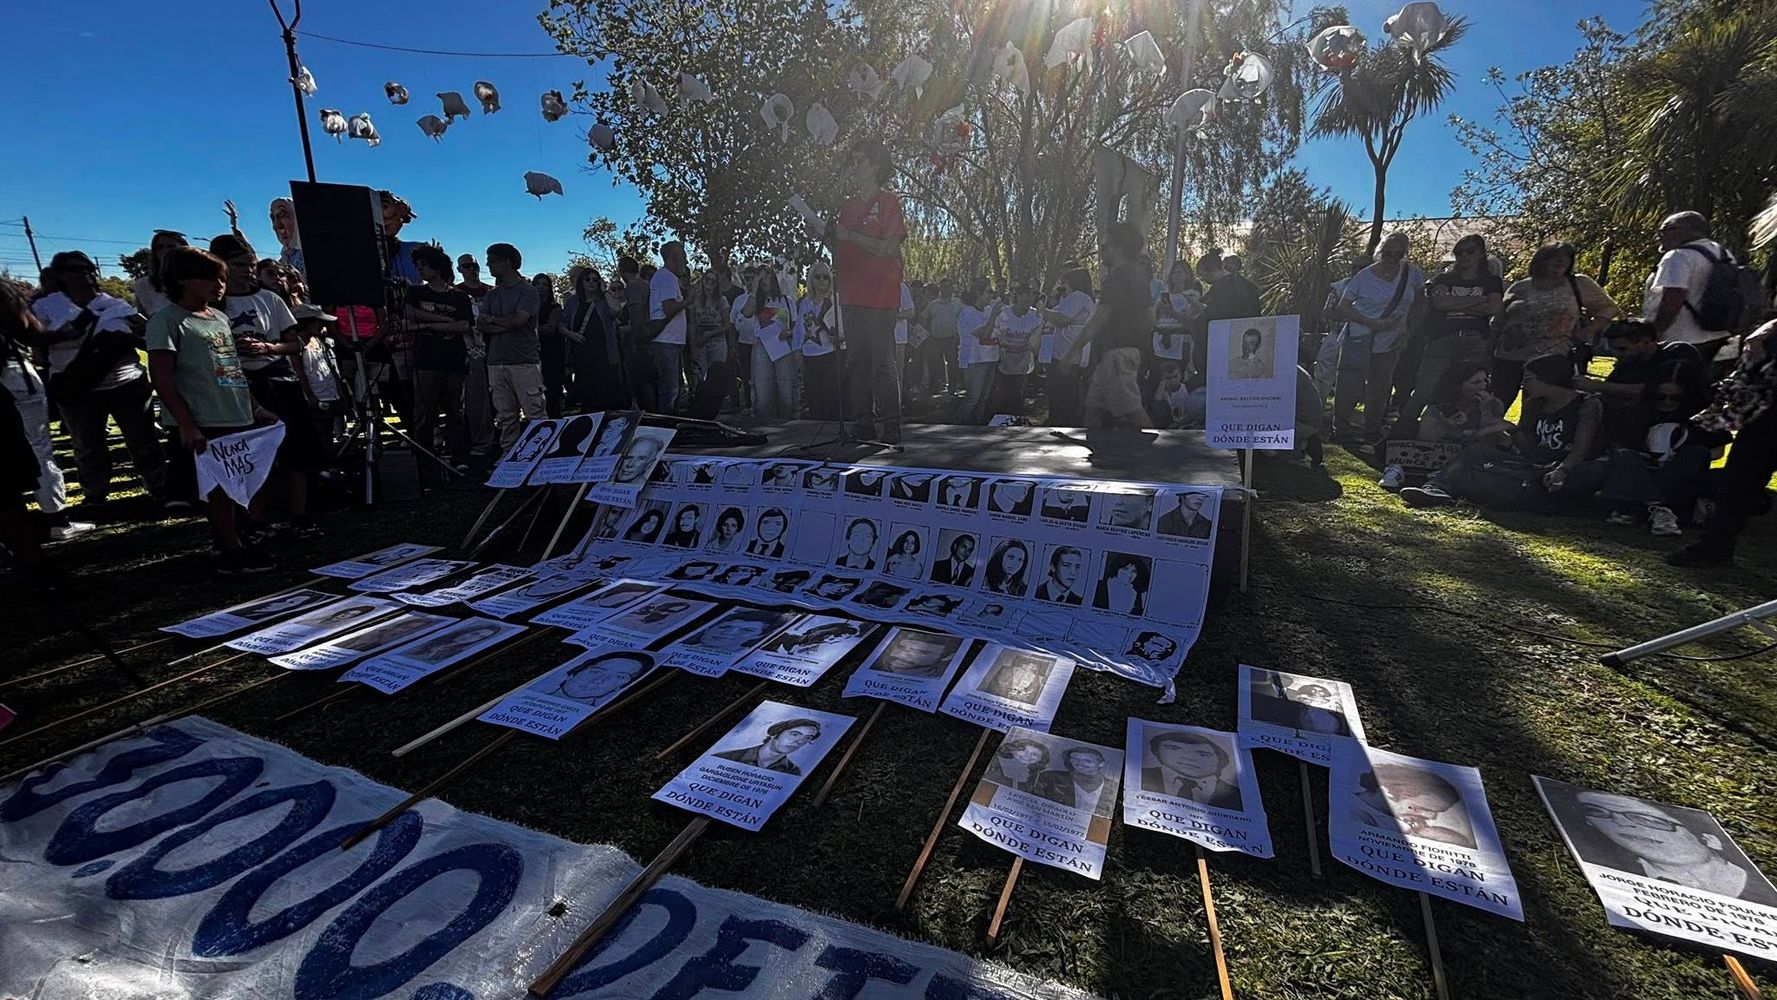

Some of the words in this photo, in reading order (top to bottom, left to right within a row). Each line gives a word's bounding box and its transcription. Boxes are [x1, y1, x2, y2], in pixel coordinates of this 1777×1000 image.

[1213, 434, 1250, 444] DÓNDE
[1253, 434, 1288, 444] ESTÁN
[1221, 424, 1244, 432] QUE
[1246, 424, 1281, 432] DIGAN
[210, 438, 250, 462] NUNCA
[590, 633, 608, 641] QUE
[608, 639, 637, 648] DIGAN
[692, 654, 722, 666] DIGAN
[755, 660, 775, 670] QUE
[778, 665, 812, 676] DIGAN
[864, 680, 888, 690] QUE
[488, 712, 522, 726] DÓNDE
[525, 720, 562, 736] ESTÁN
[509, 704, 531, 714] QUE
[532, 710, 568, 723] DIGAN
[950, 707, 994, 725] DÓNDE
[964, 701, 992, 714] QUE
[993, 709, 1034, 726] DIGAN
[700, 774, 740, 789] DICIEMBRE
[716, 764, 740, 775] RUBEN
[742, 770, 774, 782] HORACIO
[748, 778, 784, 792] URTASUN
[666, 790, 712, 812] DÓNDE
[715, 804, 762, 825] ESTÁN
[688, 782, 716, 796] QUE
[719, 790, 763, 810] DIGAN
[990, 816, 1024, 834] QUE
[1028, 829, 1084, 854] DIGAN
[1150, 810, 1185, 826] QUE
[1191, 820, 1248, 840] DIGAN
[972, 822, 1030, 854] DÓNDE
[1034, 847, 1093, 873] ESTÁN
[1358, 836, 1426, 857] NOVIEMBRE
[1428, 852, 1447, 862] DE
[1360, 830, 1418, 848] ARMANDO
[1421, 844, 1472, 860] FIORITTI
[1360, 844, 1404, 864] QUE
[1414, 858, 1486, 882] DIGAN
[1346, 855, 1424, 884] DÓNDE
[1431, 876, 1508, 906] ESTÁN
[1600, 872, 1646, 890] JORGE
[1648, 882, 1716, 906] HORACIO
[1633, 886, 1700, 910] FEBRERO
[1703, 904, 1729, 916] DE
[1624, 905, 1725, 940] DÓNDE
